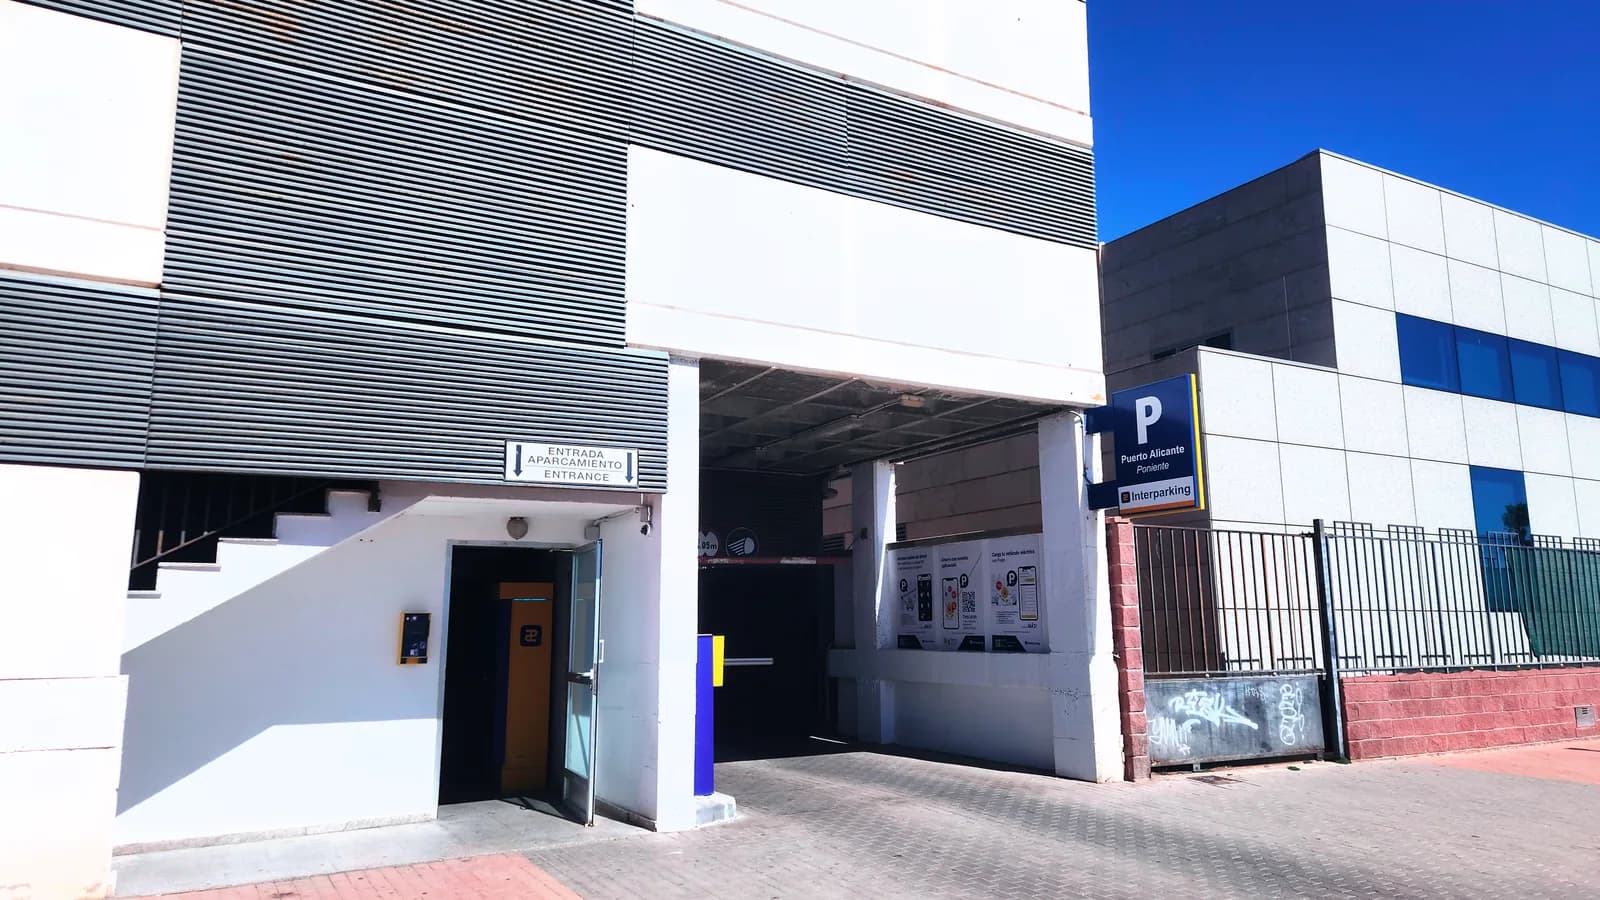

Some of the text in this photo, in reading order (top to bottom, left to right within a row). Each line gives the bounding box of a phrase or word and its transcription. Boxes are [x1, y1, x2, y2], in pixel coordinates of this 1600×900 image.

[1135, 396, 1162, 445] P
[548, 447, 604, 459] ENTRADA
[1121, 445, 1185, 464] Puerto Alicante
[527, 455, 622, 470] APARCAMIENTO
[1136, 461, 1170, 474] Poniente
[544, 470, 609, 482] ENTRANCE
[1131, 485, 1191, 502] Interparking
